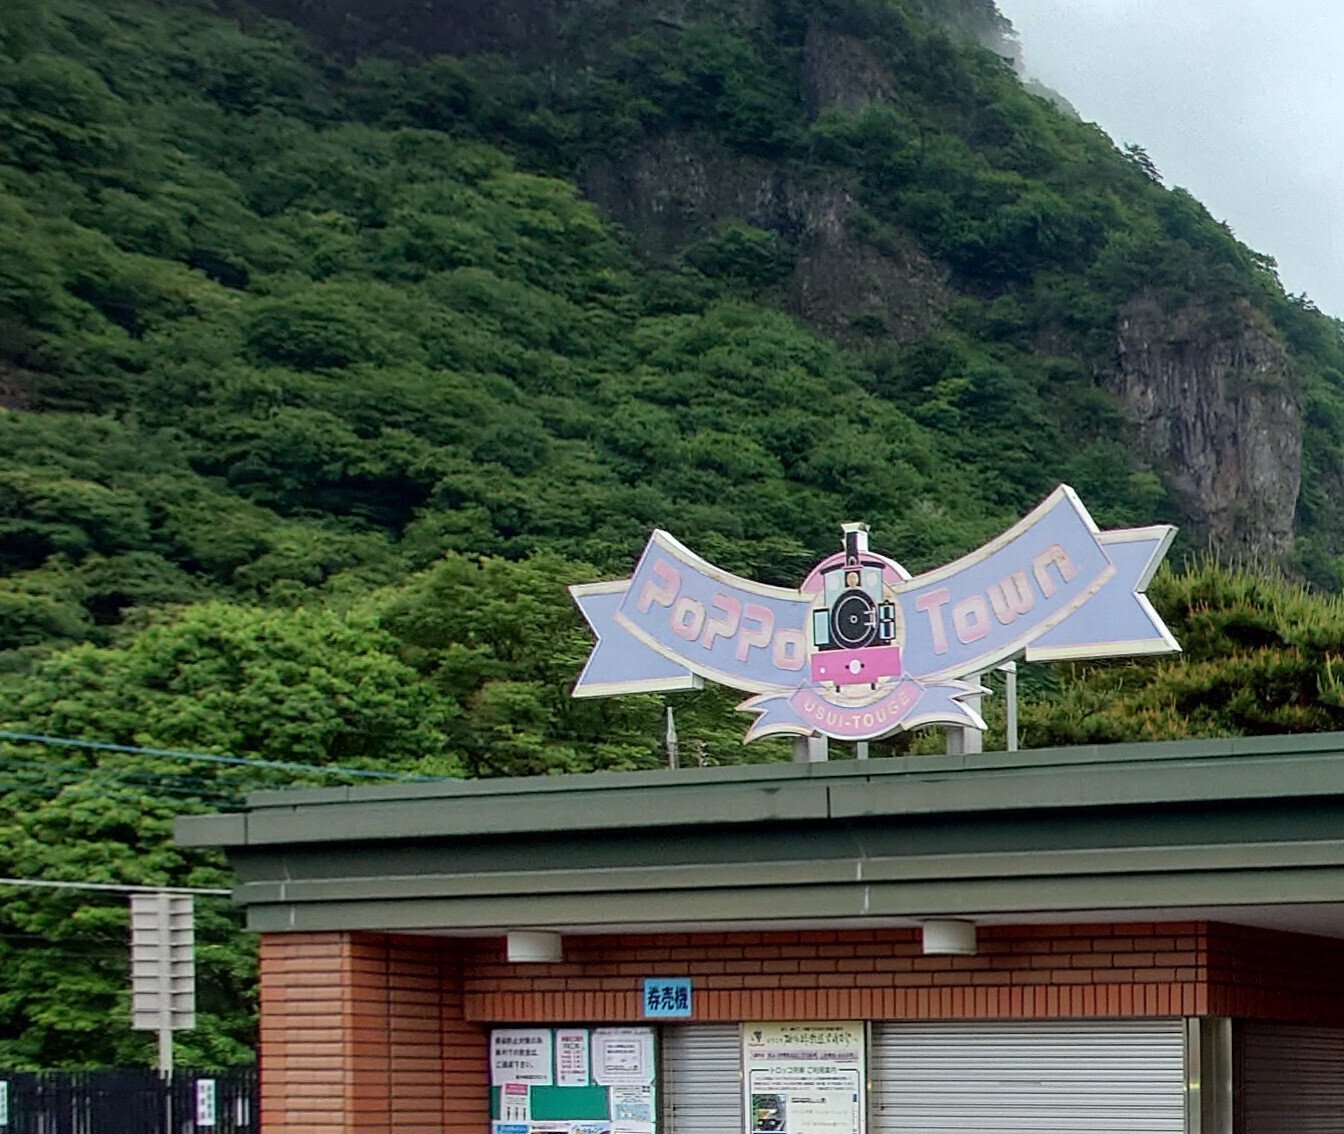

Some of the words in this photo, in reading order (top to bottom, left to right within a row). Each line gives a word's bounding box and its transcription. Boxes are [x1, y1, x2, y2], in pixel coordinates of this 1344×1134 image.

[804, 691, 911, 729] USUI-TOUGE
[648, 986, 688, 1010] 券売機
